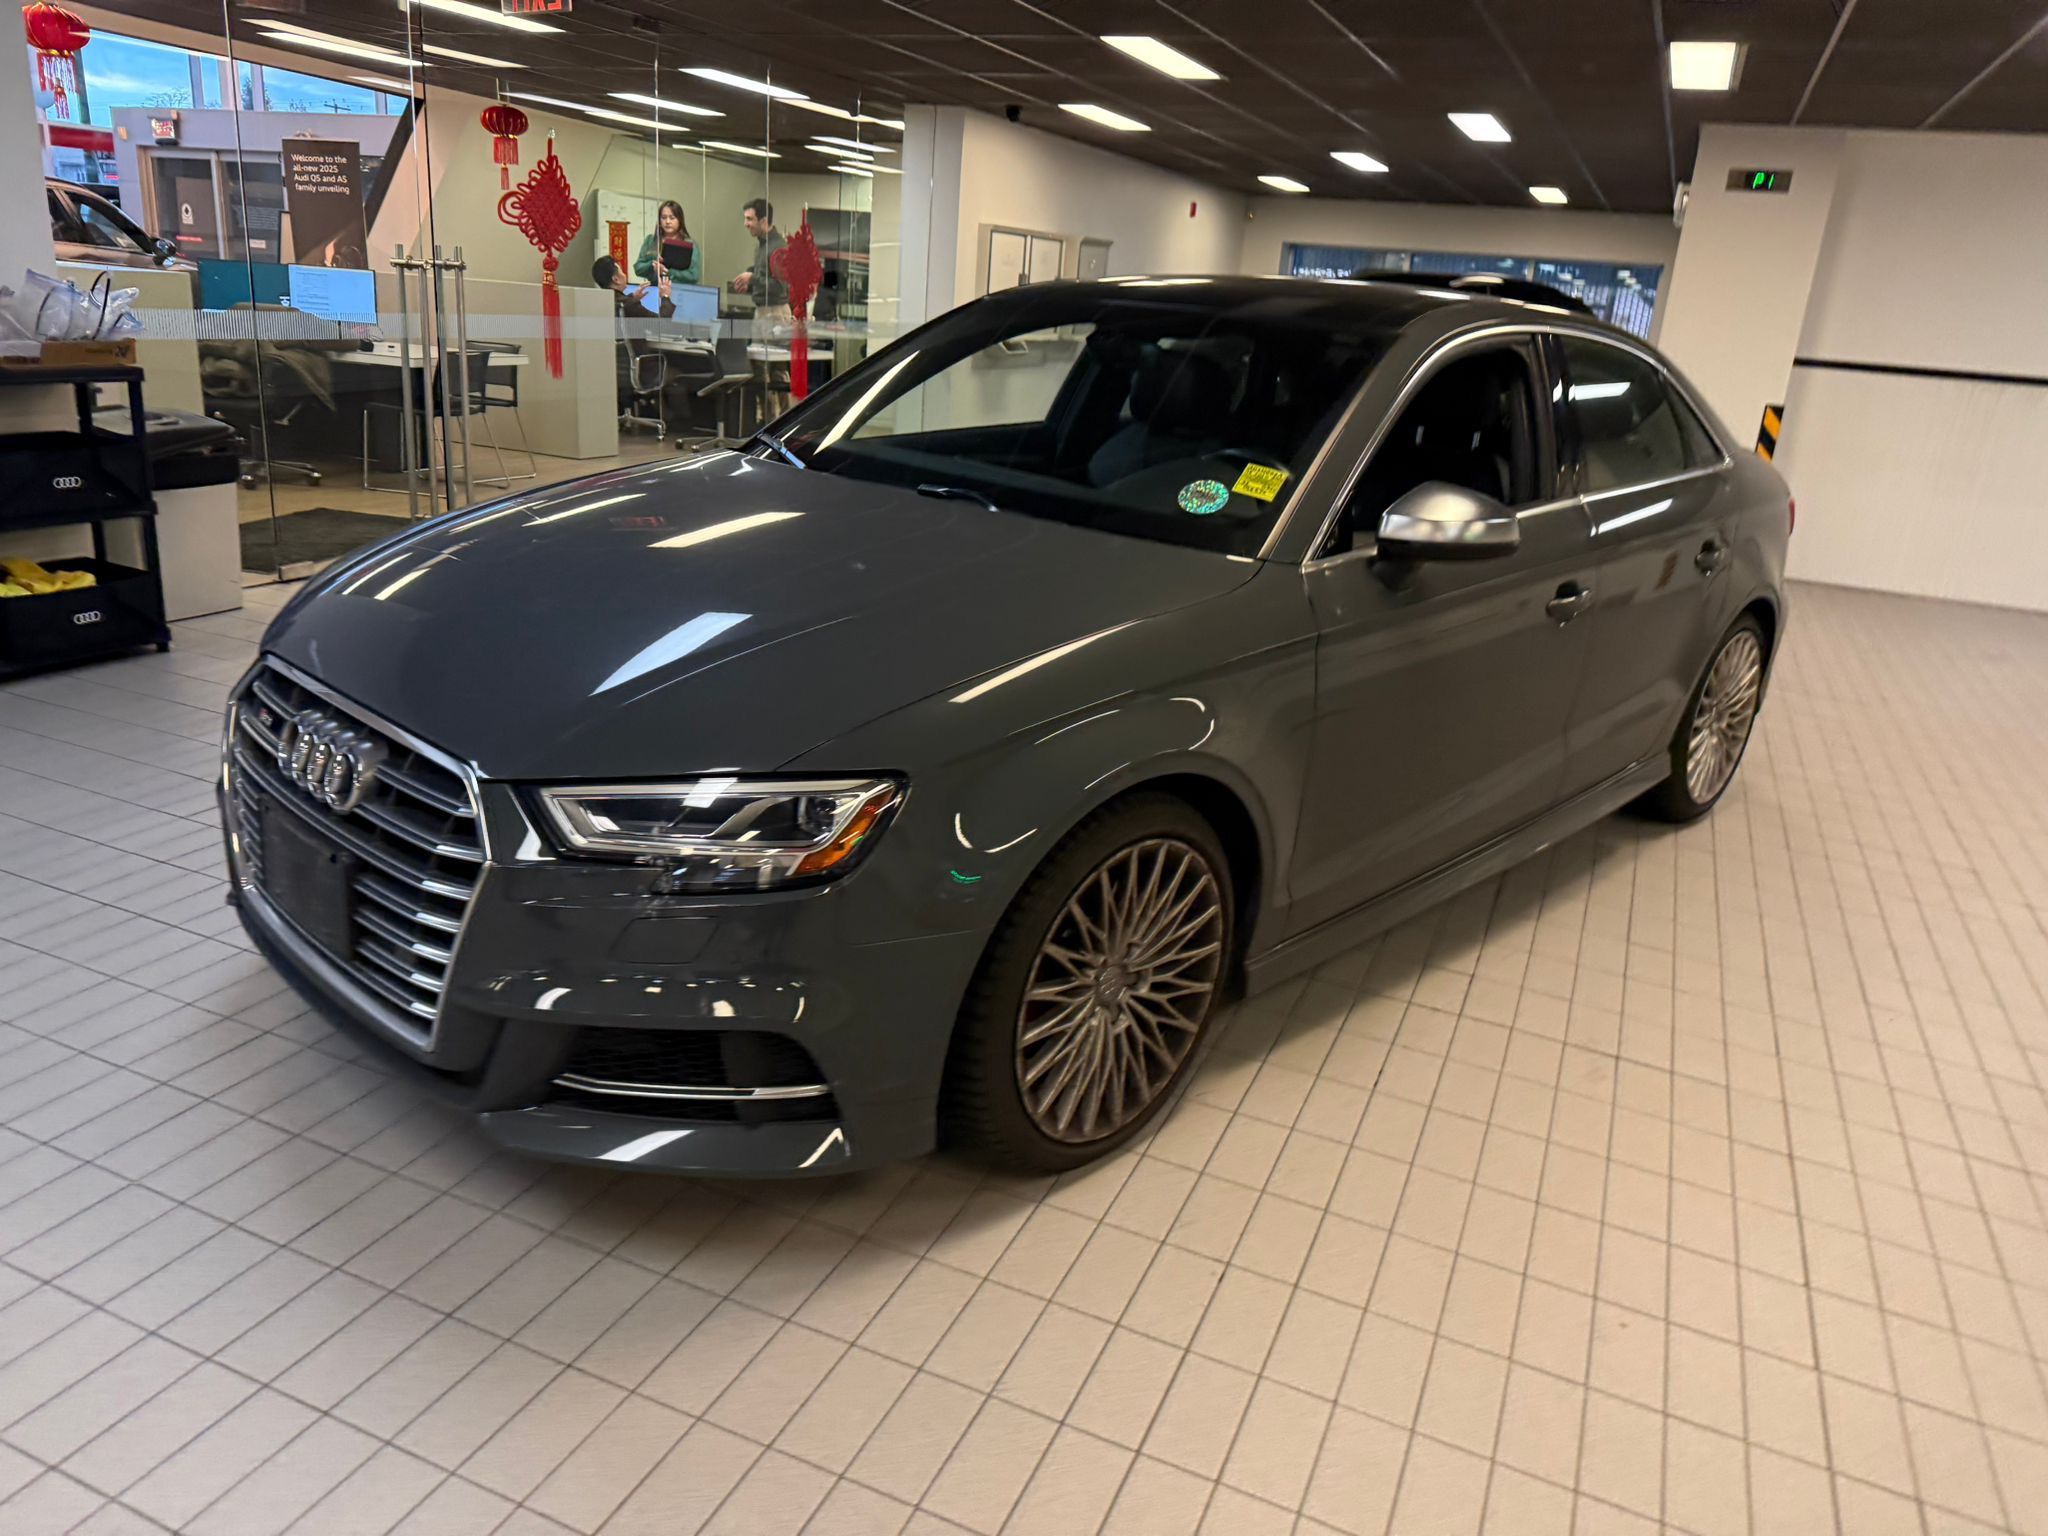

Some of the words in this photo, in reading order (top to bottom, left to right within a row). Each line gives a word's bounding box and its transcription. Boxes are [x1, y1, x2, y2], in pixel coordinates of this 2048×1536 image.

[291, 154, 324, 163] Welcome
[335, 156, 347, 164] the
[293, 164, 318, 172] all-new
[320, 164, 338, 173] 2025
[294, 173, 310, 182] Audi
[322, 175, 336, 183] and
[295, 183, 317, 193] family
[318, 185, 349, 195] unveiling
